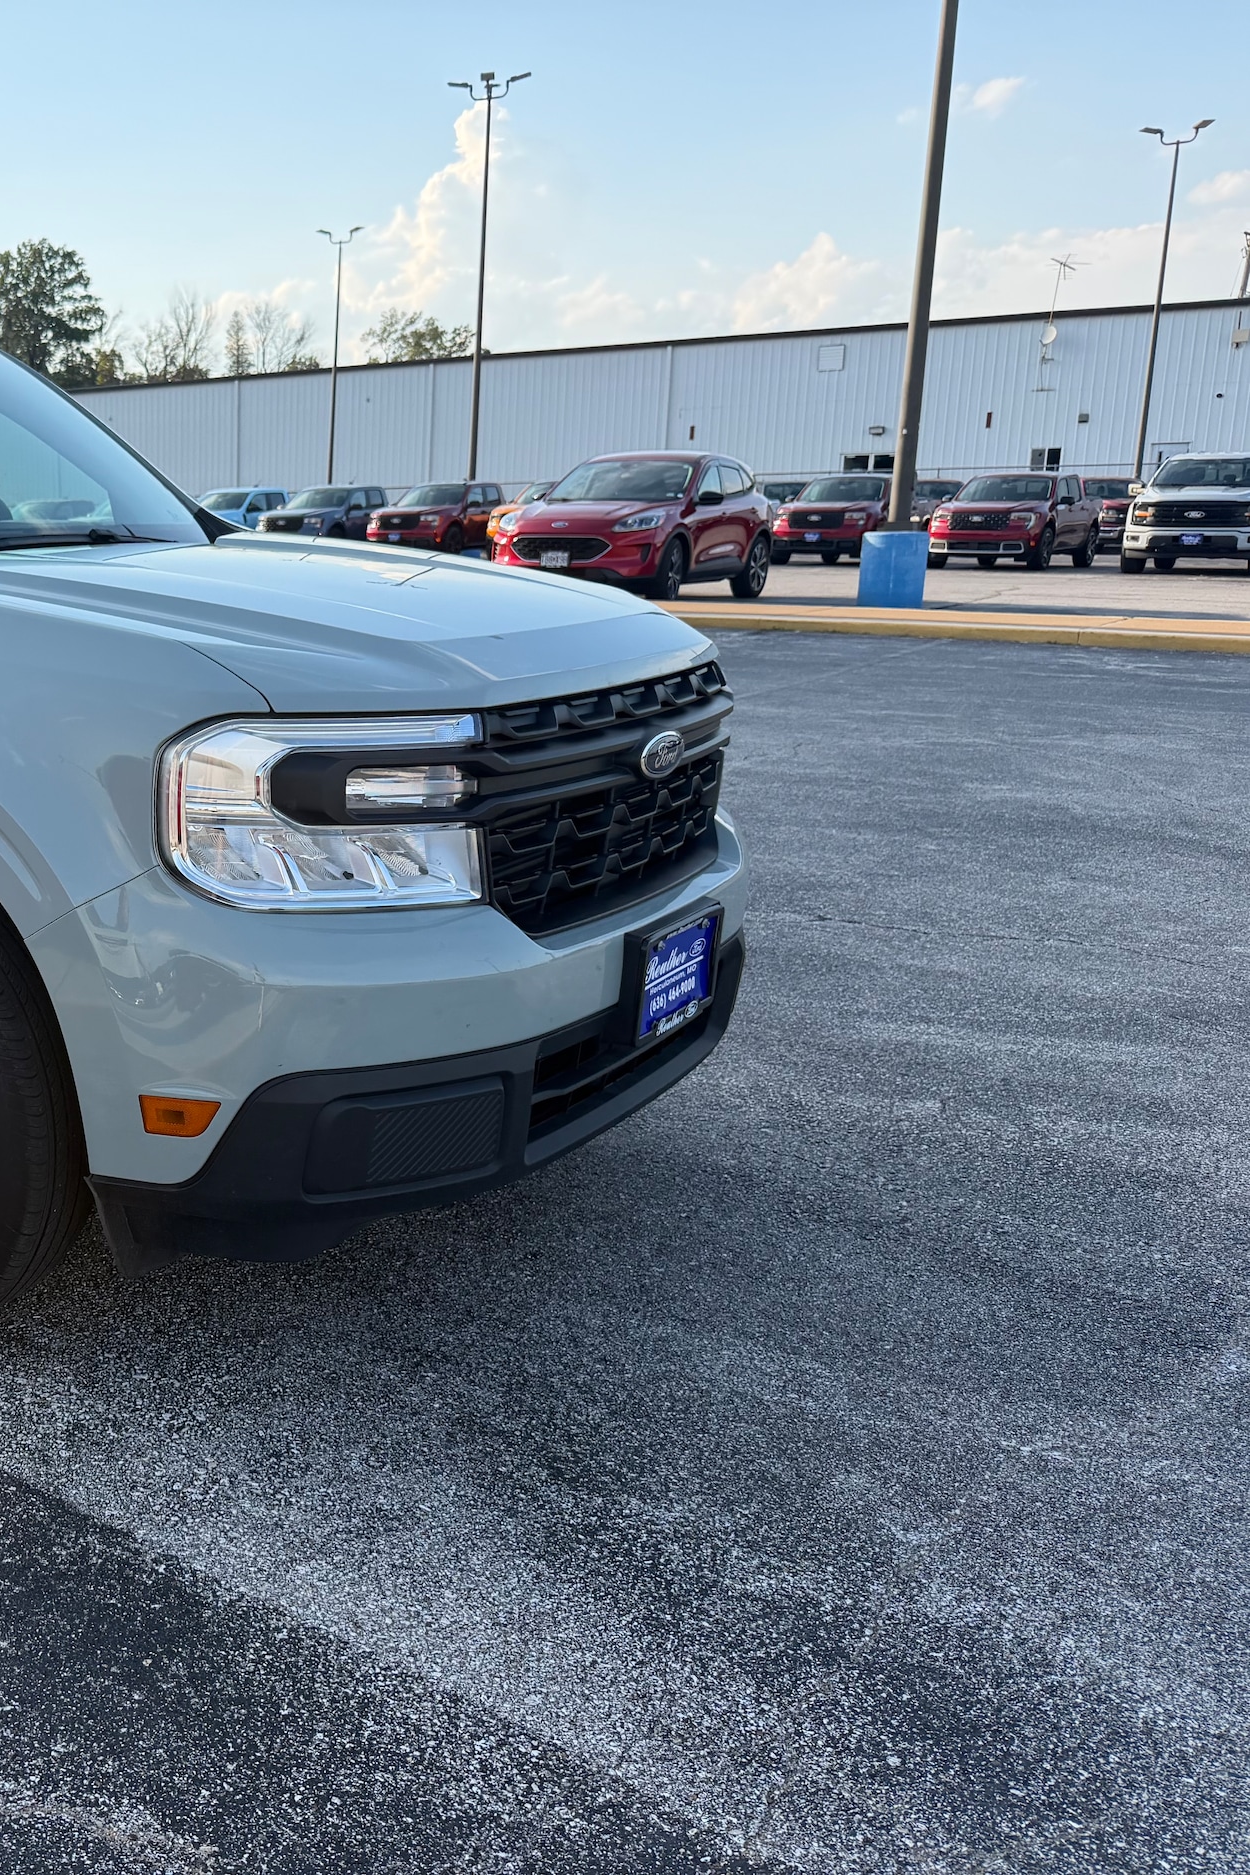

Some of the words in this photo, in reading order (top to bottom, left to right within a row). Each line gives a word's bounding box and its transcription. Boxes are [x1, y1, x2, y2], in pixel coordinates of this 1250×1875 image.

[653, 740, 682, 769] Ford
[645, 947, 688, 984] Reuther
[650, 993, 667, 1016] (636)
